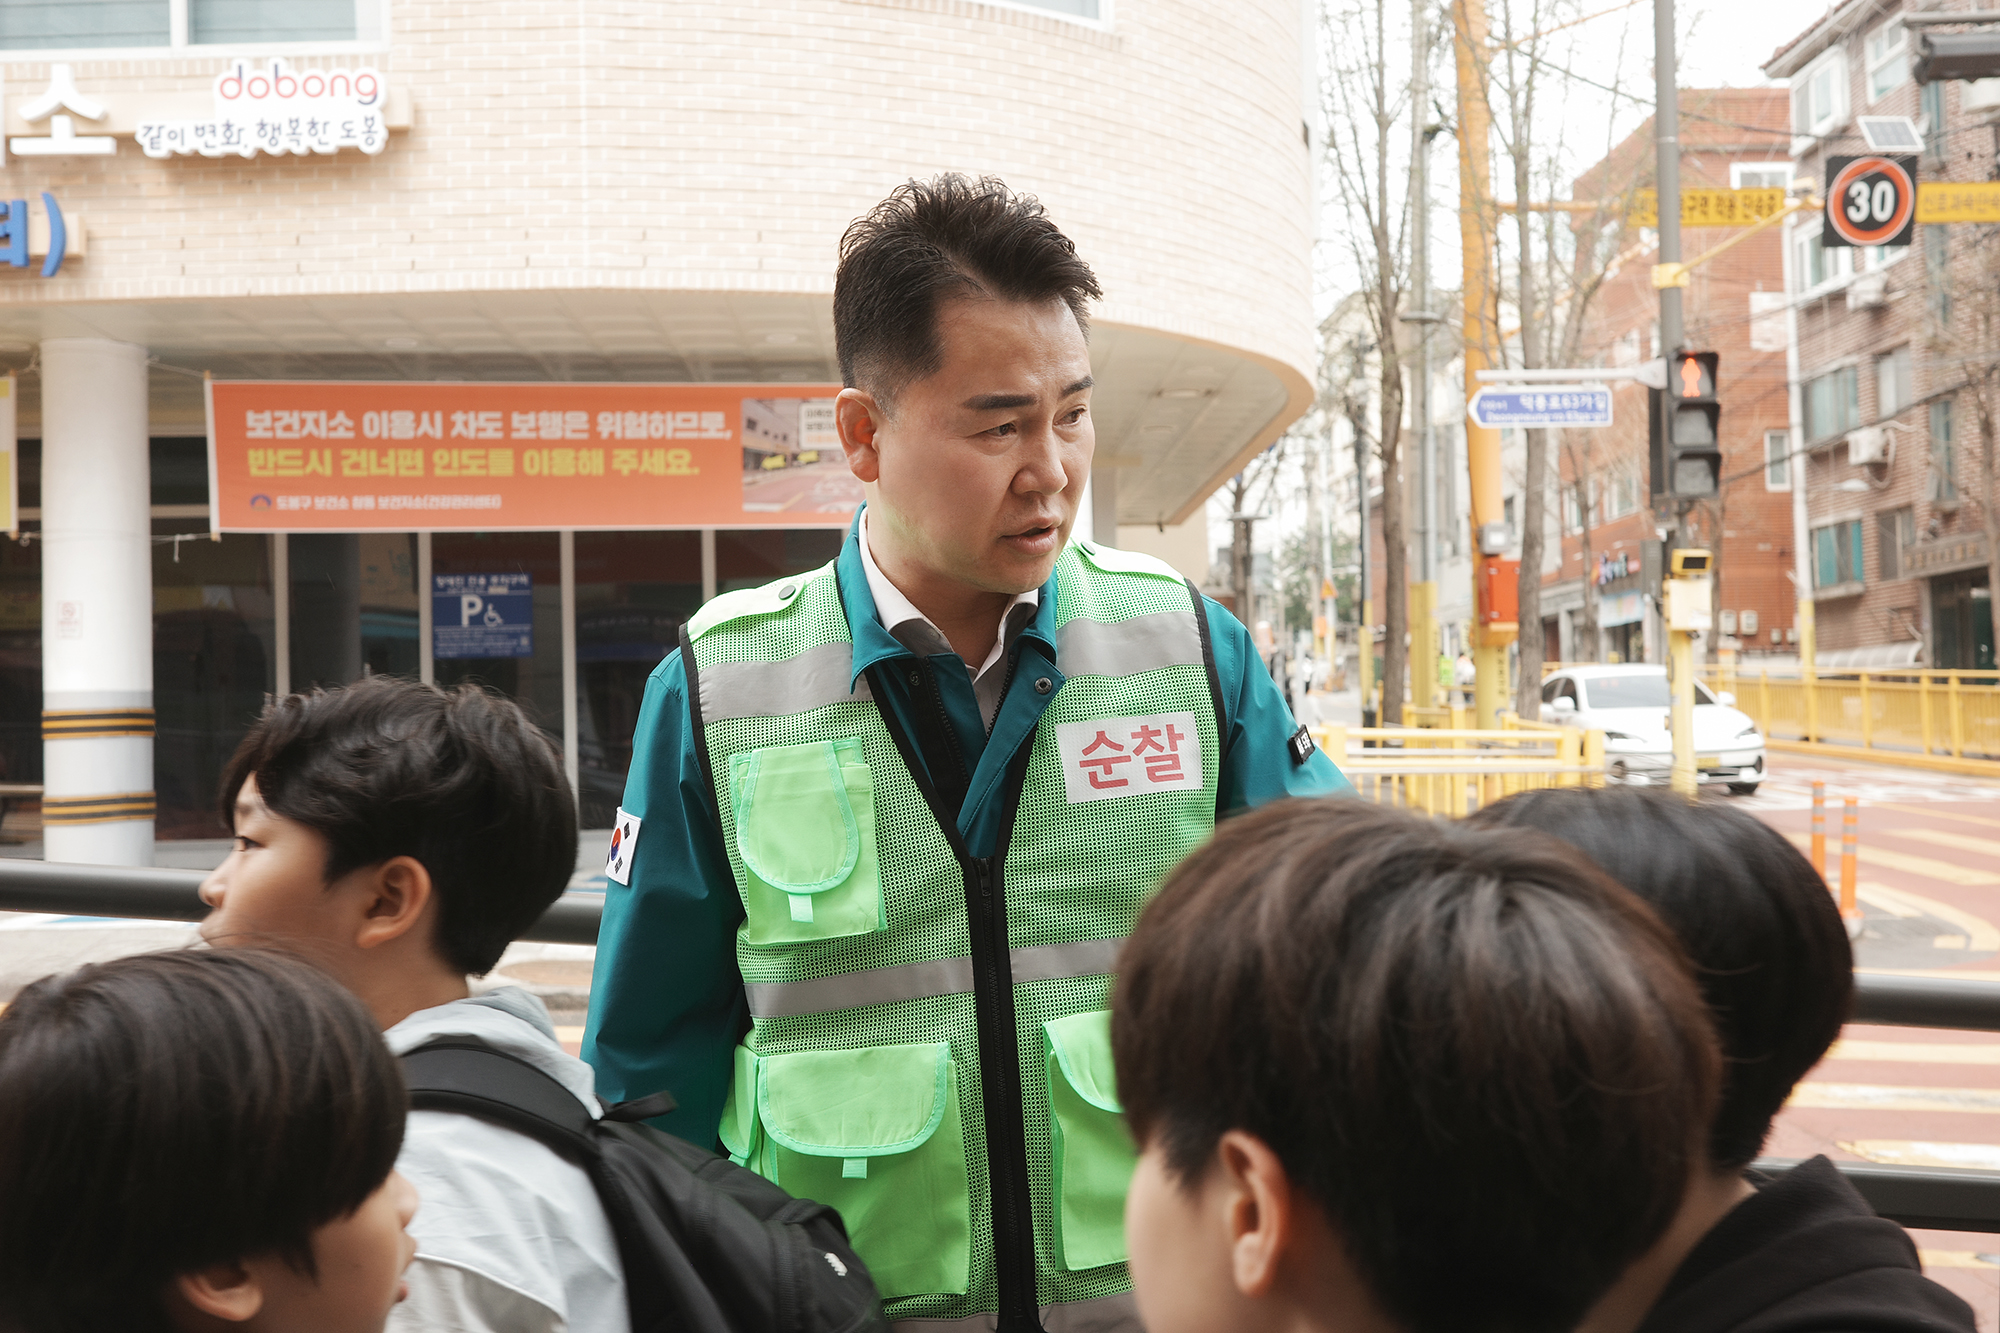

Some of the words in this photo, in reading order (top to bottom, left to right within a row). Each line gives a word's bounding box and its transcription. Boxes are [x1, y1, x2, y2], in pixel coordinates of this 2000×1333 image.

[219, 64, 378, 105] dobong
[0, 64, 117, 167] 소
[142, 125, 185, 150] 같이
[256, 116, 331, 147] 행복한
[340, 115, 378, 146] 도봉
[1847, 180, 1896, 223] 30
[245, 410, 355, 439] 보건지소
[362, 410, 443, 439] 이용시
[450, 410, 504, 439] 차도
[511, 410, 590, 440] 보행은
[596, 410, 733, 440] 위험하므로,
[247, 448, 333, 477] 반드시
[340, 448, 425, 477] 건너편
[432, 448, 515, 477] 인도를
[522, 448, 605, 477] 이용해
[612, 448, 700, 477] 주세요.
[460, 594, 483, 628] P
[1079, 724, 1185, 789] 순찰
